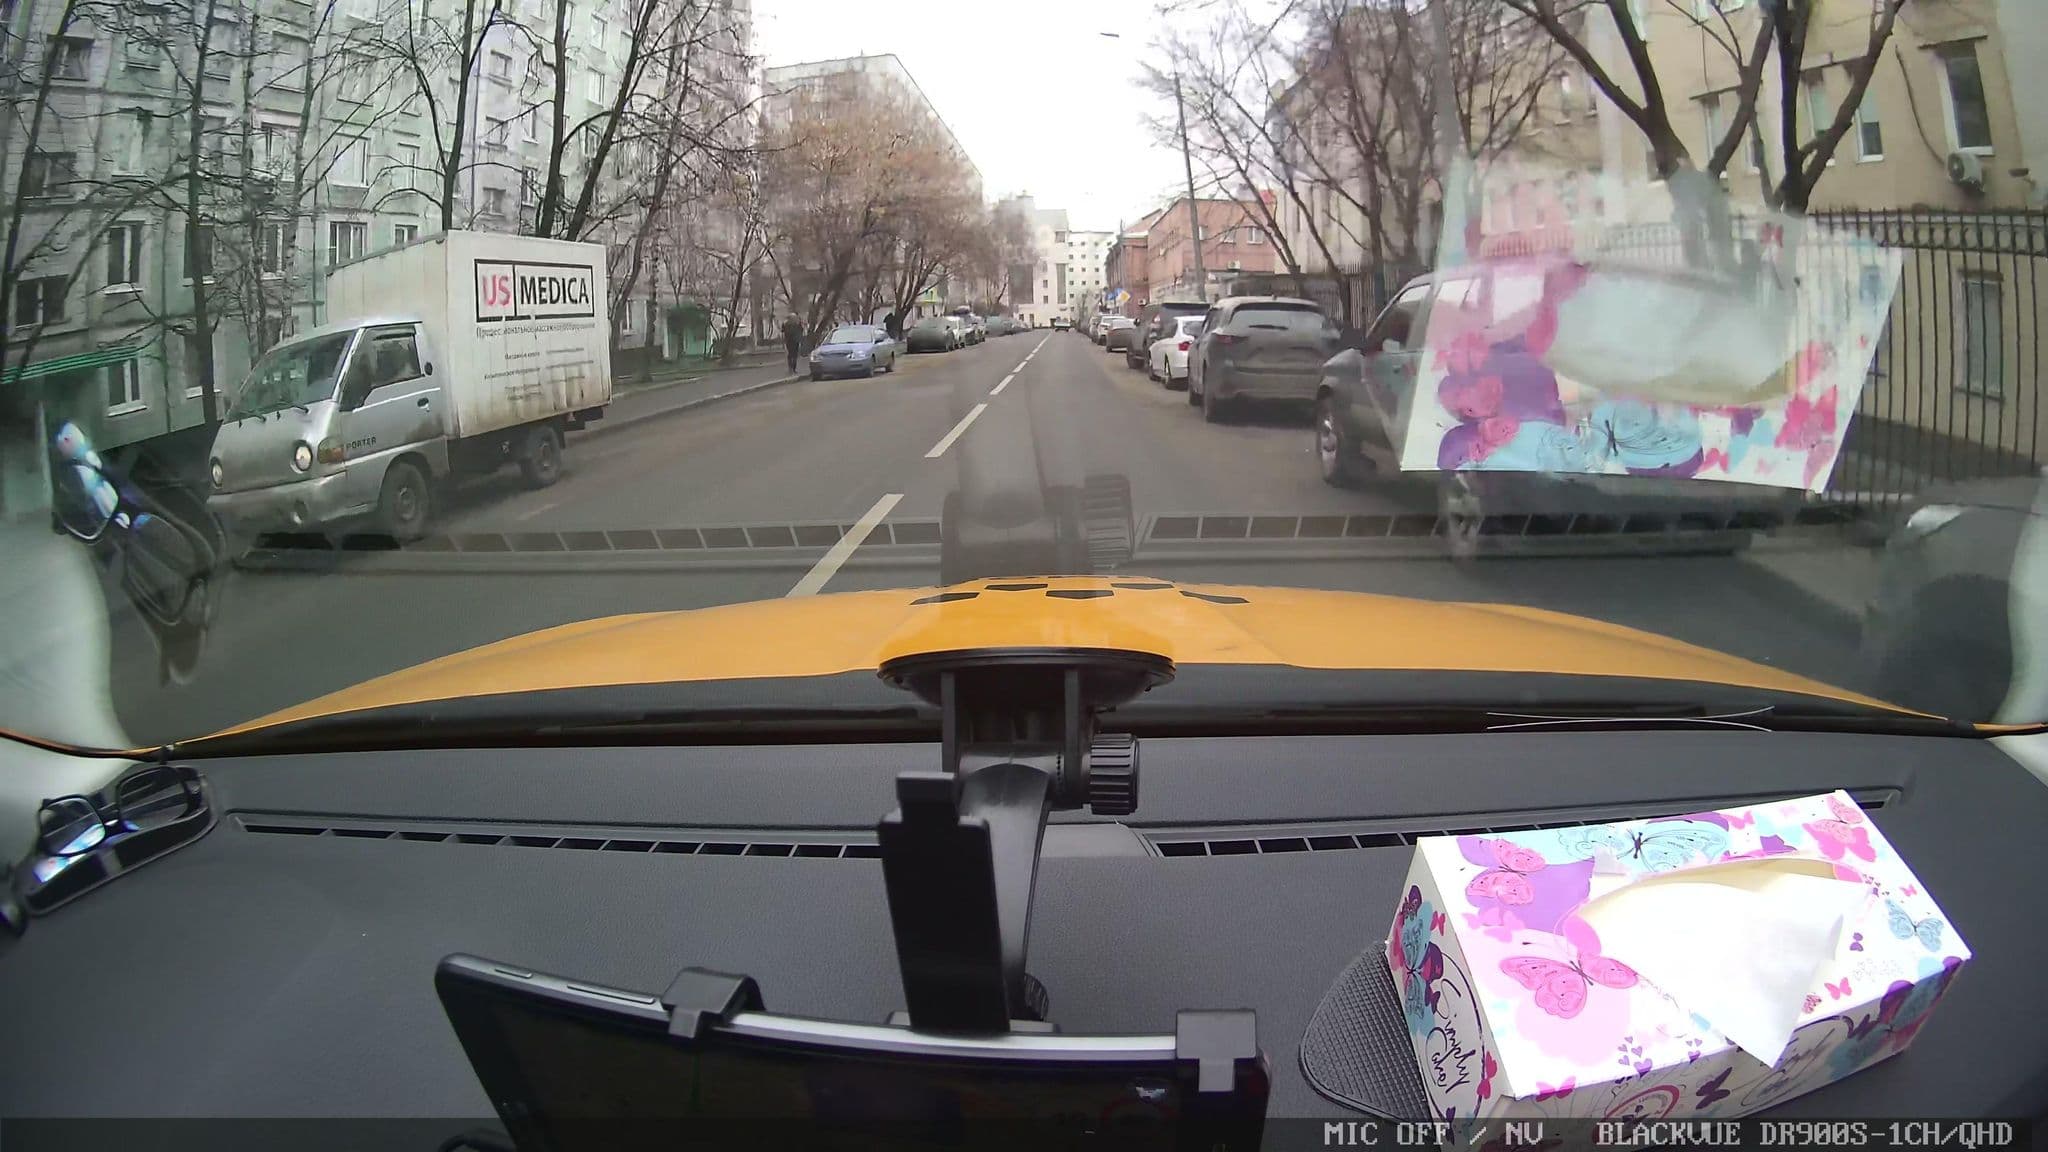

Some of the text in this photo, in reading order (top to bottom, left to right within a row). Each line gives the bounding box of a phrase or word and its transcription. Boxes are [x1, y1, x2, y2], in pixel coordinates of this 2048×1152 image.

[482, 274, 590, 307] US MEDICA
[345, 436, 377, 450] PORTER
